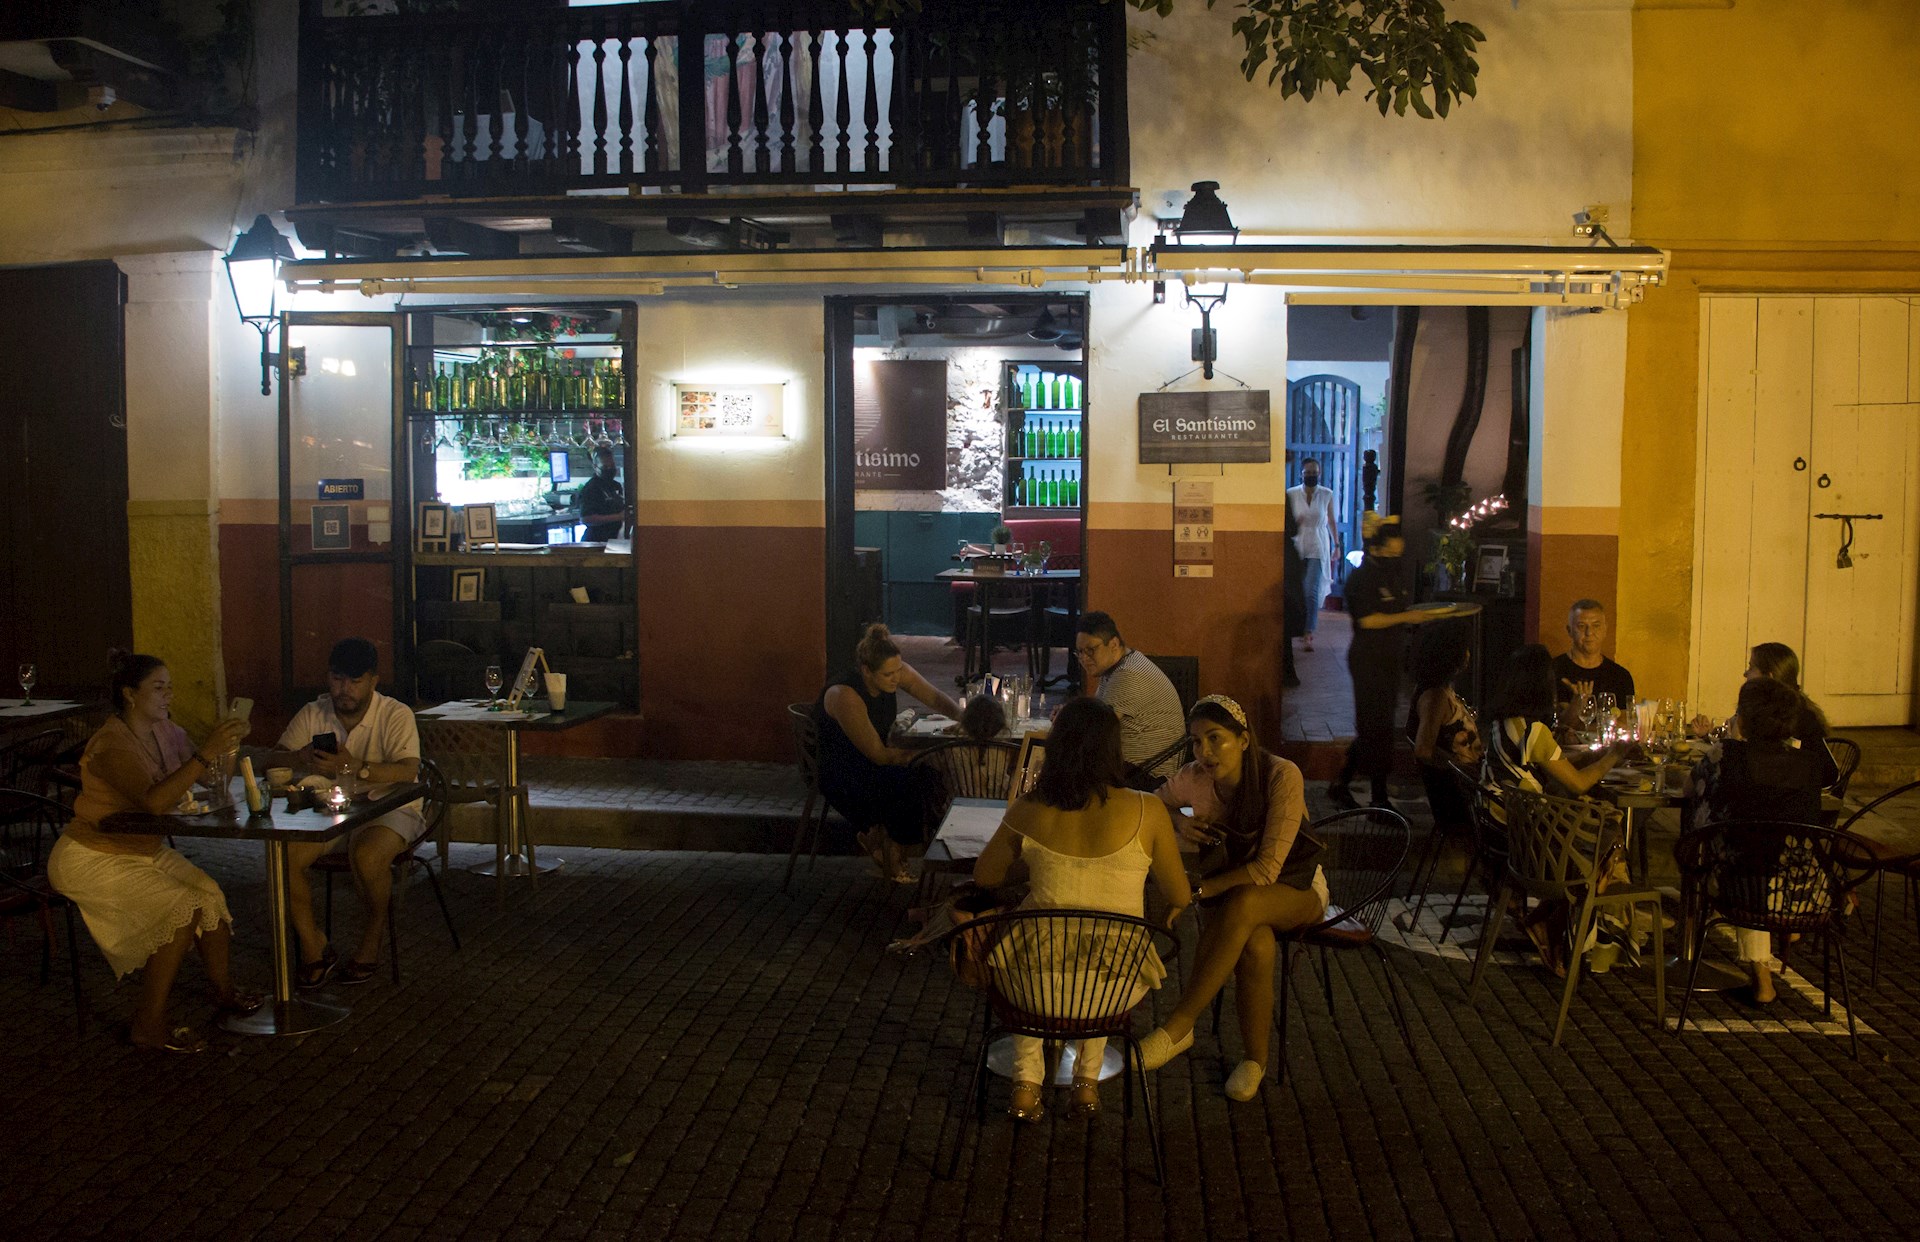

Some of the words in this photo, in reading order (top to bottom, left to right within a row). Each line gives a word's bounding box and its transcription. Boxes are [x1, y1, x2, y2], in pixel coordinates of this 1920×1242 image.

[1153, 418, 1170, 433] El
[1176, 416, 1257, 432] Santísimo
[324, 484, 359, 494] ABIERTO
